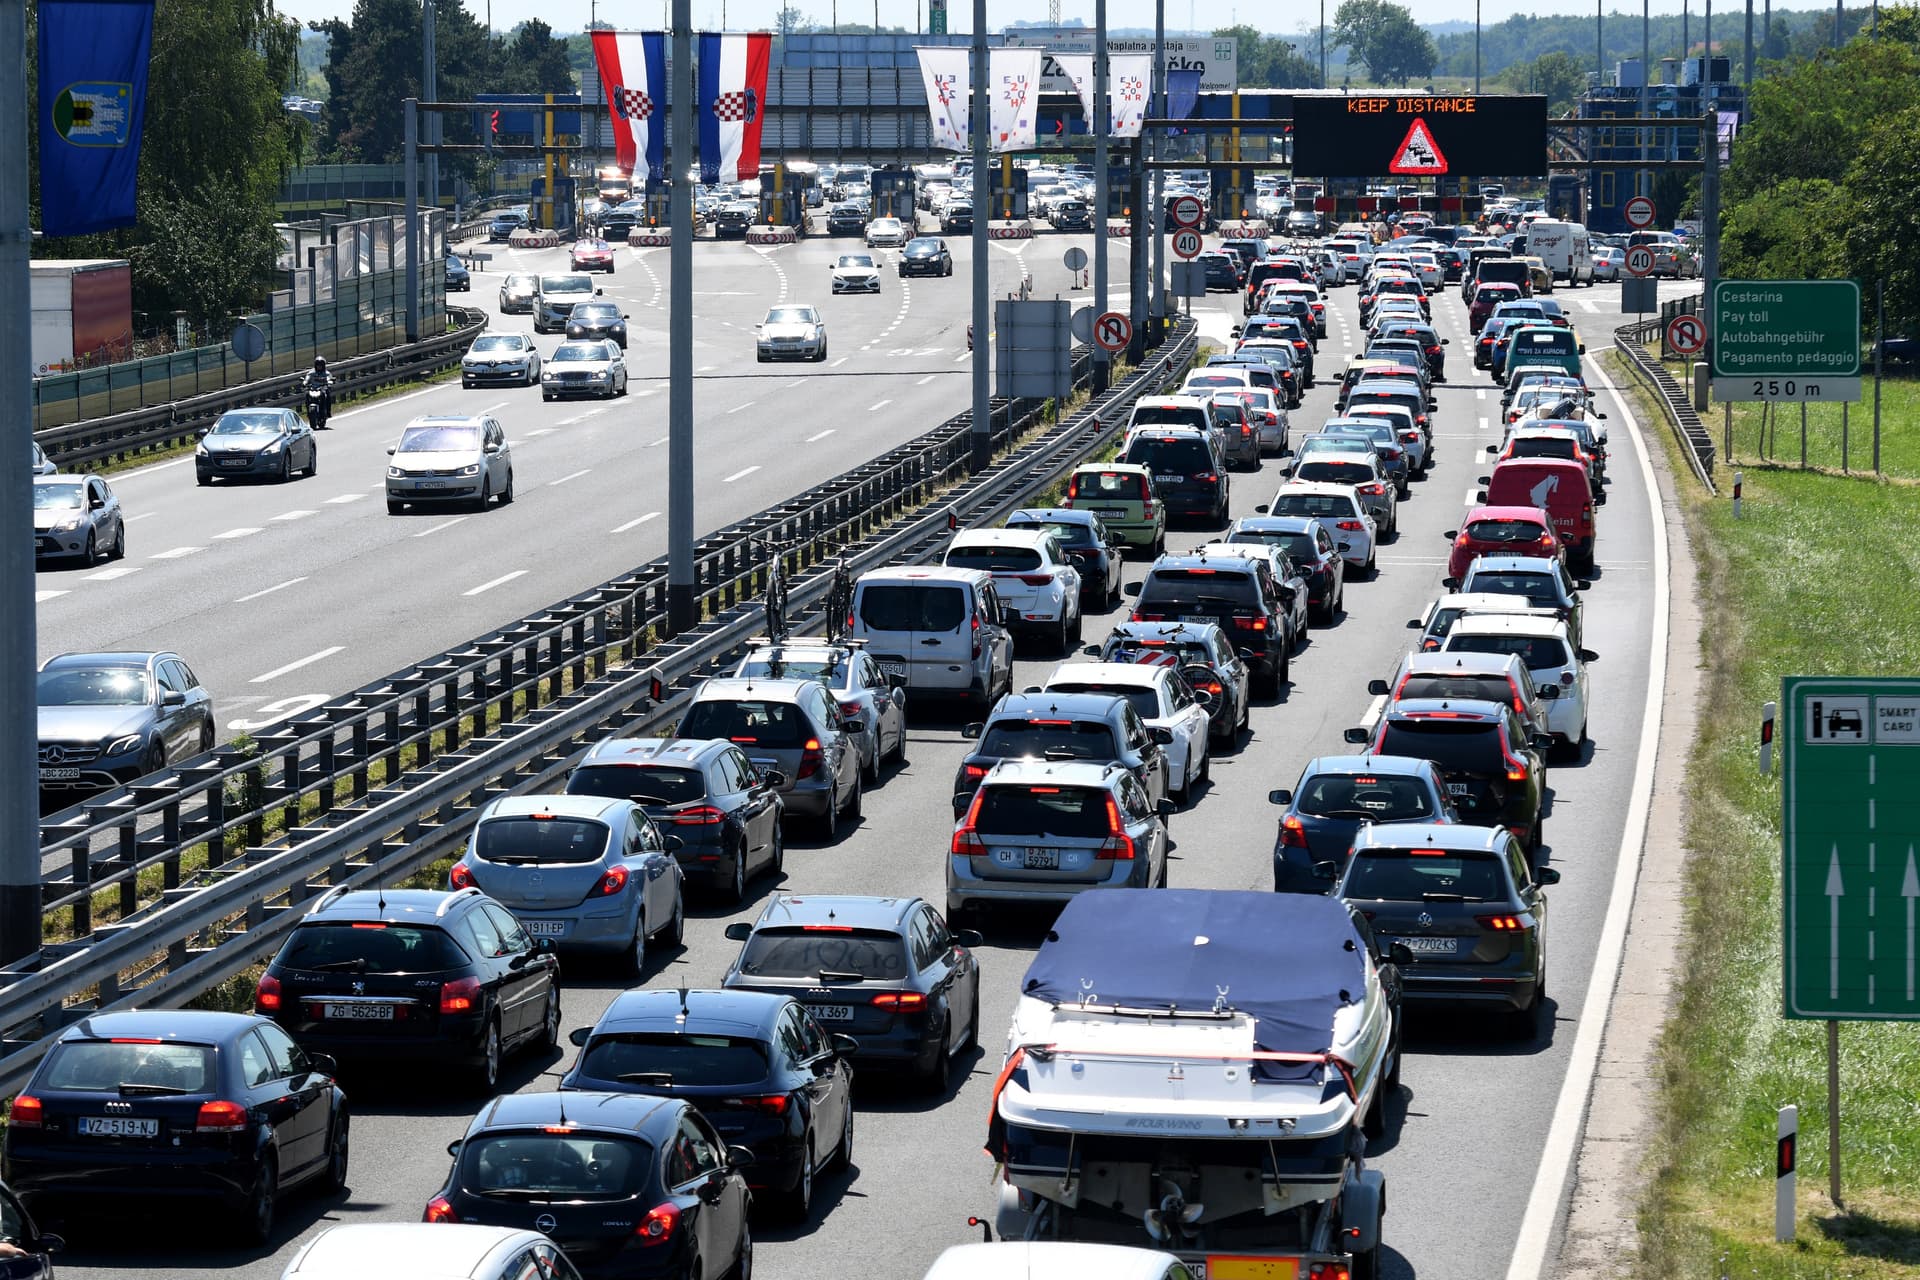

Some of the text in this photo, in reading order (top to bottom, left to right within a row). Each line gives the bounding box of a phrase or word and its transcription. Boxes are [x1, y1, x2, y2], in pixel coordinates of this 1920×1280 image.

[1106, 41, 1147, 51] Naplatna
[1348, 99, 1476, 112] KEEP DISTANCE
[1179, 236, 1196, 251] 40
[1632, 253, 1649, 269] 40
[1721, 291, 1783, 303] Cestarina
[1721, 311, 1769, 325] Pay toll
[1721, 331, 1825, 345] Autobahngebühr
[1721, 351, 1854, 365] Pagamento pedaggio
[1753, 381, 1820, 396] 250 m
[1553, 518, 1574, 527] einl
[1879, 708, 1916, 717] SMART
[1883, 722, 1913, 731] CARD
[1000, 851, 1012, 861] CH
[331, 1006, 392, 1018] ZG 5625-BF
[827, 1008, 849, 1018] 369
[87, 1120, 103, 1133] VZ
[111, 1121, 157, 1135] 519-NJ
